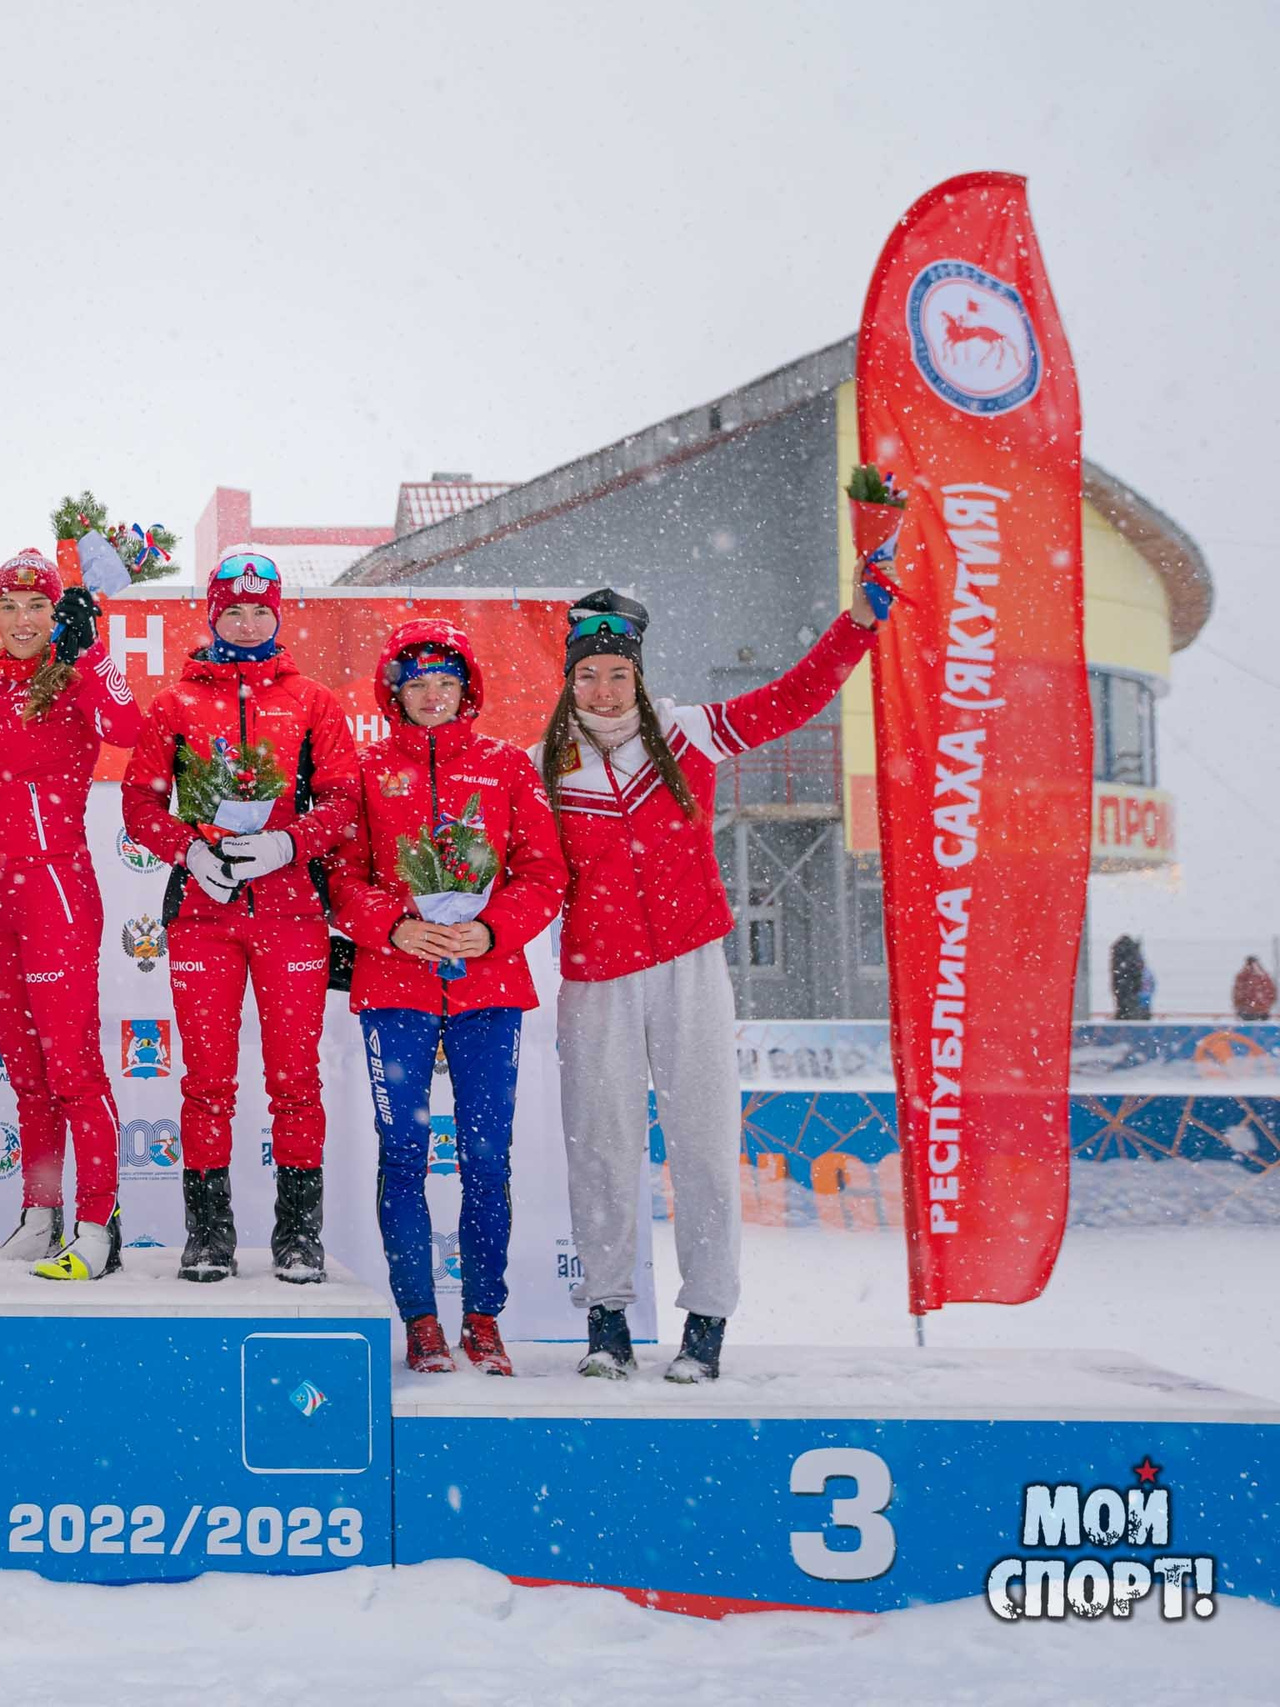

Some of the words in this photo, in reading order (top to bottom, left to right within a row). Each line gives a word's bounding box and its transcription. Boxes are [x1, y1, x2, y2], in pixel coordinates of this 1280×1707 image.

[940, 482, 1011, 711] (ЯКУТИЯ)
[932, 728, 987, 869] САХА
[287, 959, 324, 972] BOSCO
[370, 1056, 394, 1126] BELARUS
[927, 887, 974, 1234] РЕСПУБЛИКА
[8, 1504, 365, 1558] 2022/2023
[789, 1447, 897, 1582] 3
